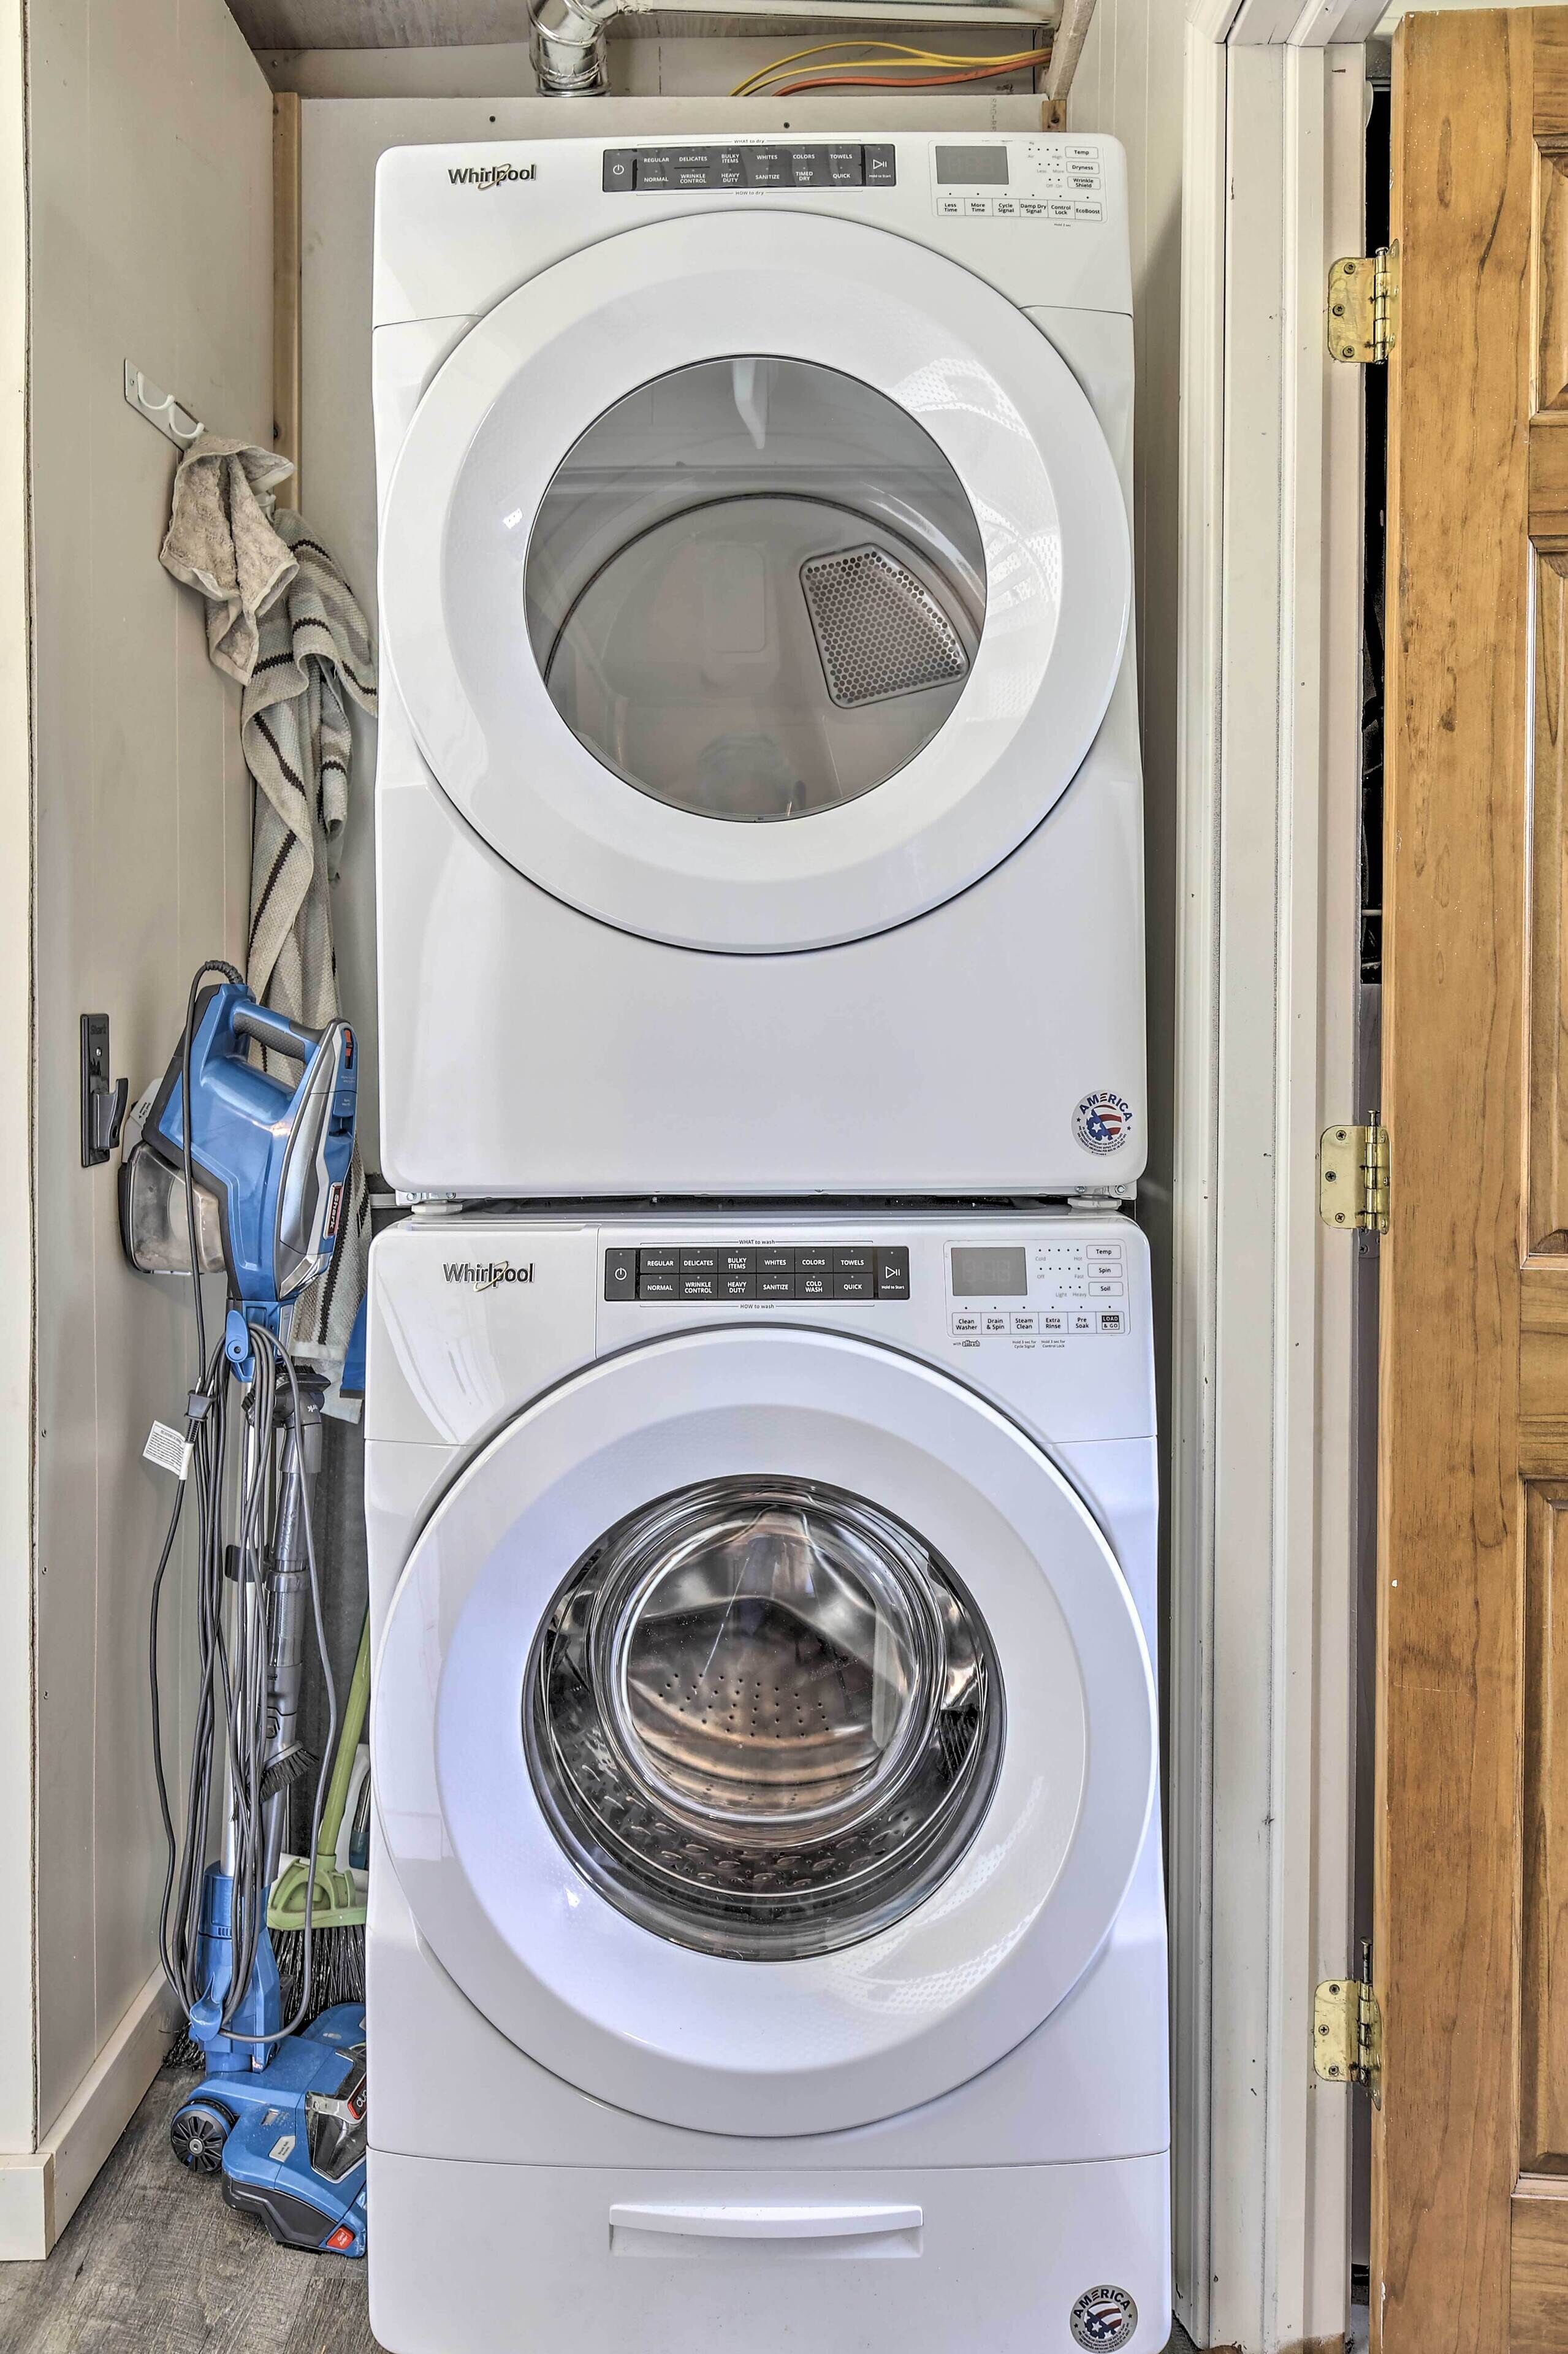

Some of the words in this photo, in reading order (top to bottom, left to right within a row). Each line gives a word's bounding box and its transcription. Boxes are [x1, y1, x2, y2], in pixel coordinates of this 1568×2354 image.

[448, 164, 536, 188] Whirlpool
[1079, 1092, 1133, 1122] AMERICA
[330, 1194, 340, 1229] Shark
[443, 1262, 535, 1290] Whirlpool
[1073, 2289, 1130, 2319] AMERICA
